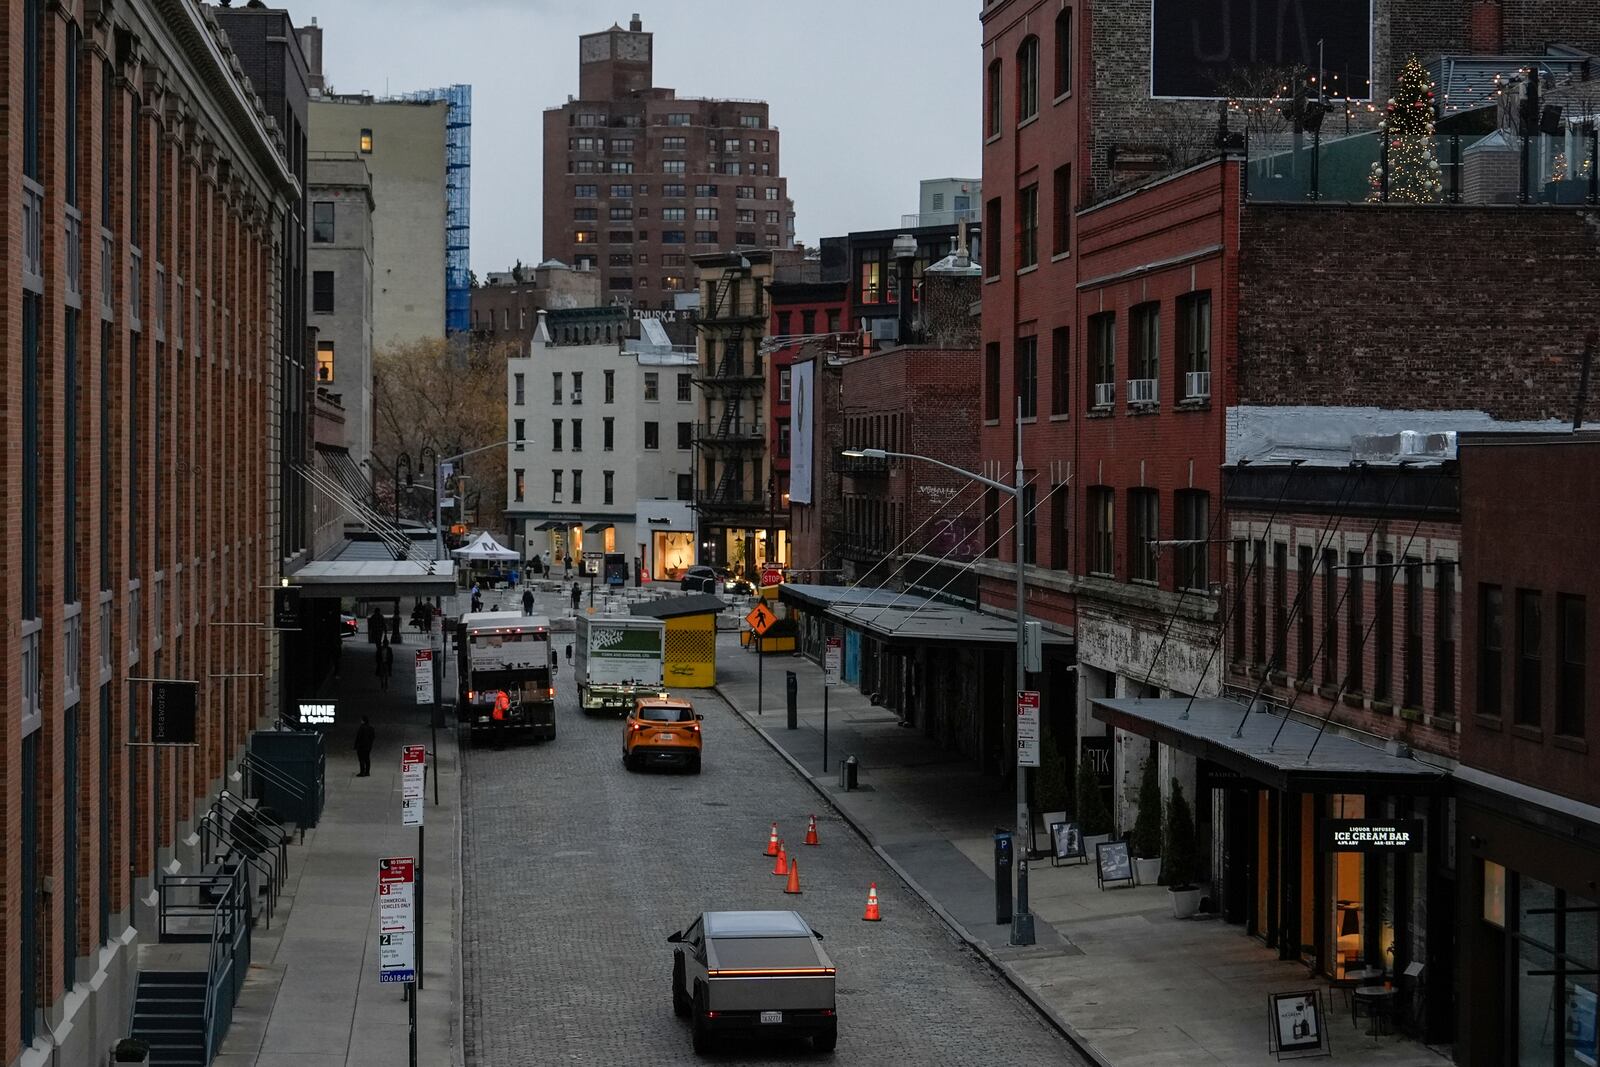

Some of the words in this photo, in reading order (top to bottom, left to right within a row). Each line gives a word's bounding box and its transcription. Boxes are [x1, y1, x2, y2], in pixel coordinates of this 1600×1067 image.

[482, 542, 499, 551] M
[764, 575, 780, 583] STOP
[155, 687, 166, 738] betaworks
[299, 704, 336, 716] WINE
[1334, 832, 1351, 840] ICE
[1352, 832, 1387, 840] CREAM
[1389, 832, 1410, 840] BAR
[1001, 840, 1007, 848] P
[382, 884, 388, 894] 3
[382, 934, 389, 945] 2
[381, 974, 406, 982] 106184
